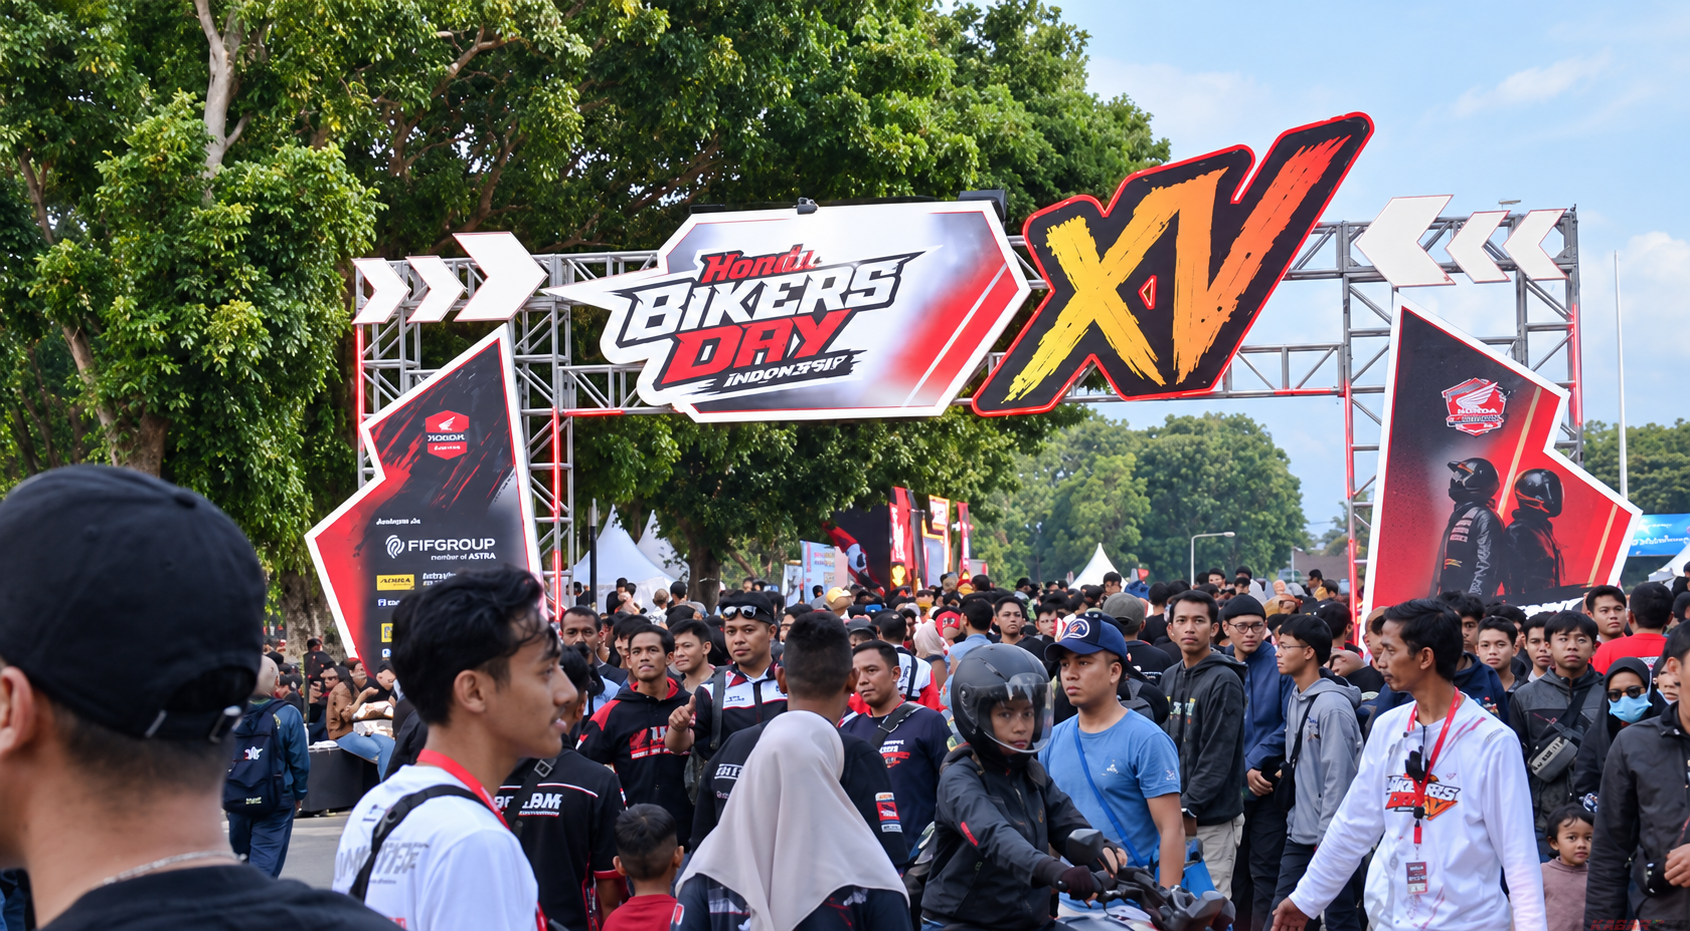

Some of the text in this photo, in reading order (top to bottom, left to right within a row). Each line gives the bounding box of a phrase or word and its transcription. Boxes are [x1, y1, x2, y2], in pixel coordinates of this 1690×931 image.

[620, 258, 911, 344] BIKERS
[1001, 134, 1352, 404] XV
[661, 308, 852, 385] DAY
[408, 538, 496, 552] FIFGROUP
[468, 552, 496, 560] ASTRA
